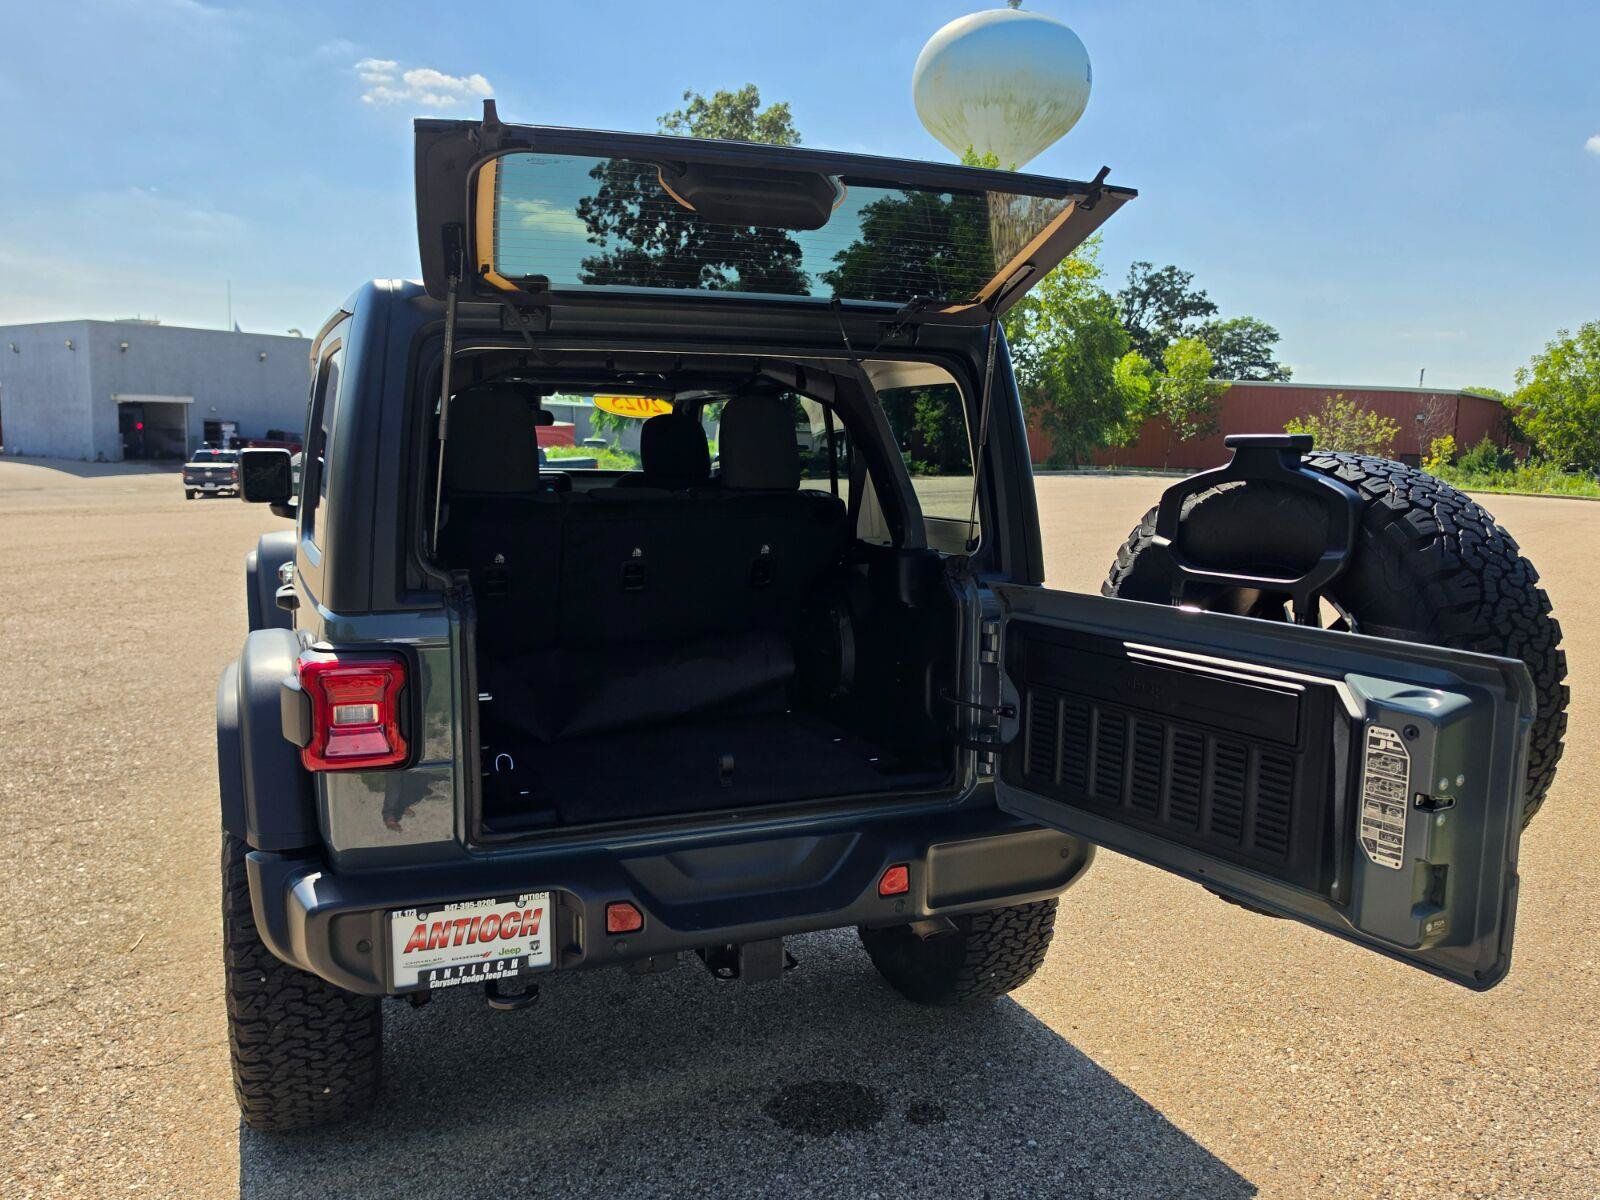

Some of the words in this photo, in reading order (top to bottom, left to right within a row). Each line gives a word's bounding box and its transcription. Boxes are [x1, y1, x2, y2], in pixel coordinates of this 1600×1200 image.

[519, 892, 550, 901] ANTIOCH
[403, 908, 543, 954] ANTIOCH
[498, 947, 522, 956] Jeep
[429, 958, 519, 982] ANTIOCH
[429, 977, 461, 989] Chrysler
[461, 974, 485, 984] Dodge
[485, 971, 502, 981] Jeep
[502, 969, 519, 978] Ram
